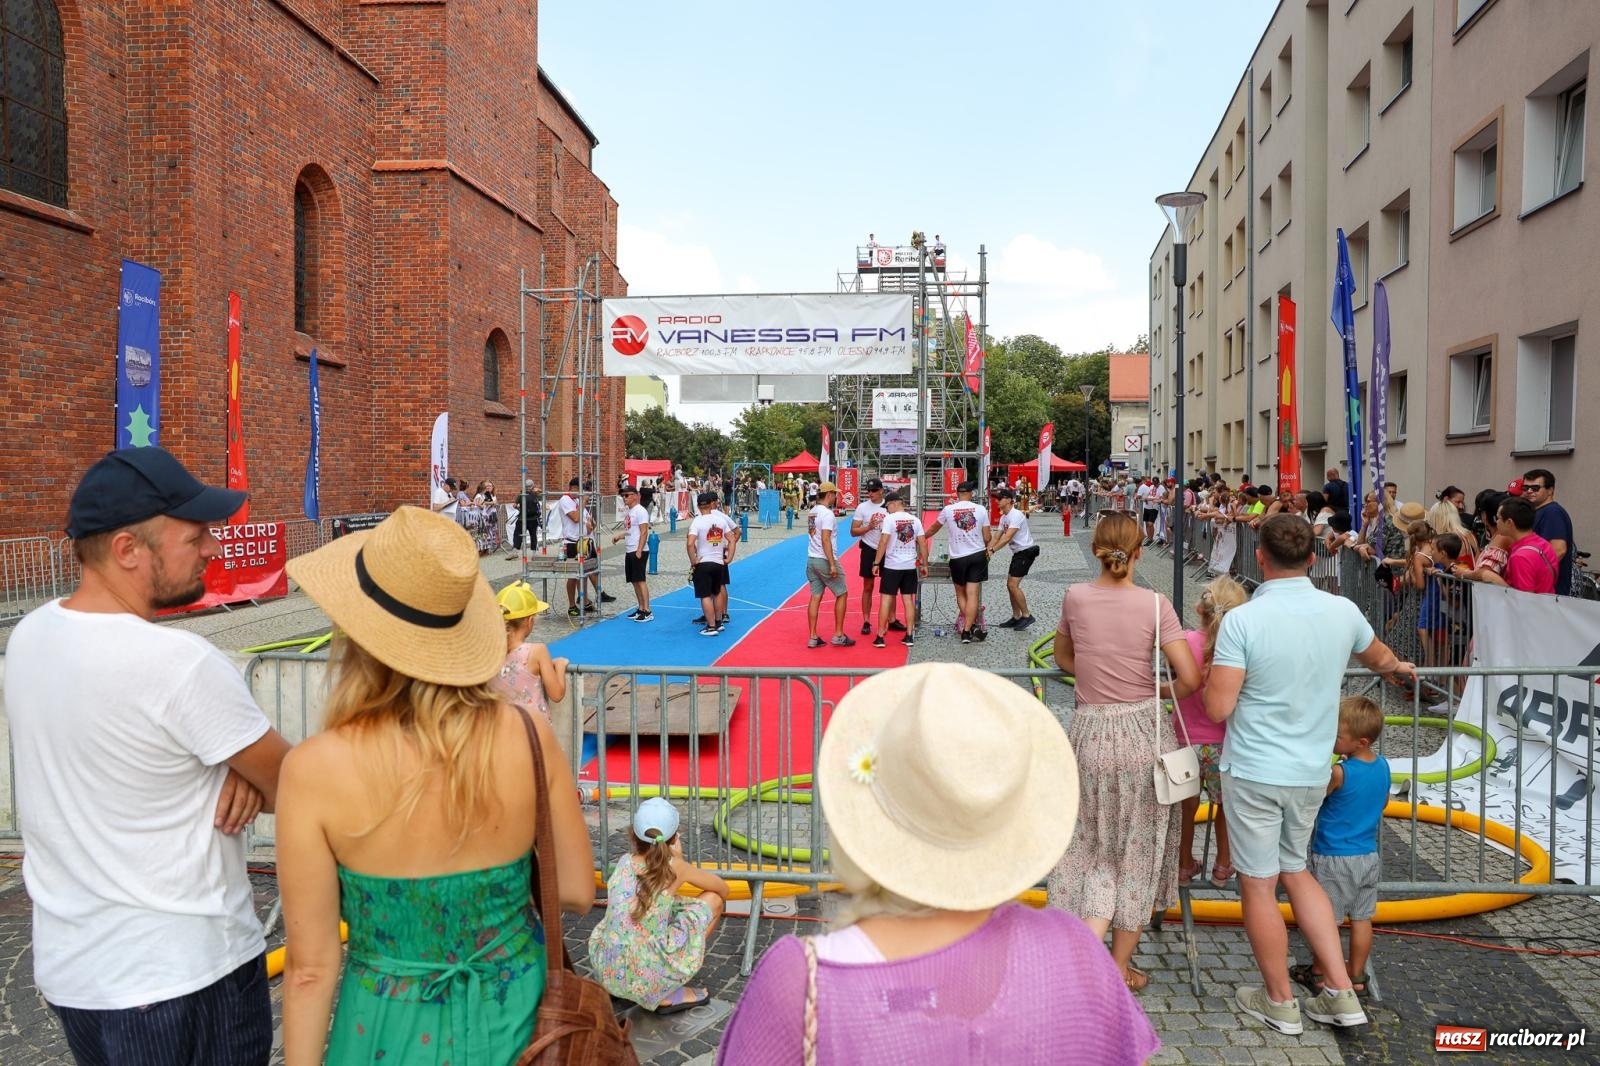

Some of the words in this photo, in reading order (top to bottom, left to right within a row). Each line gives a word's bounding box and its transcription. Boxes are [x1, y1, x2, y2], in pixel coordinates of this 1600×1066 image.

[658, 315, 721, 324] RADIO
[658, 328, 838, 344] VANESSA
[852, 327, 905, 342] FM
[209, 523, 277, 541] REKORD
[224, 560, 238, 570] SP.
